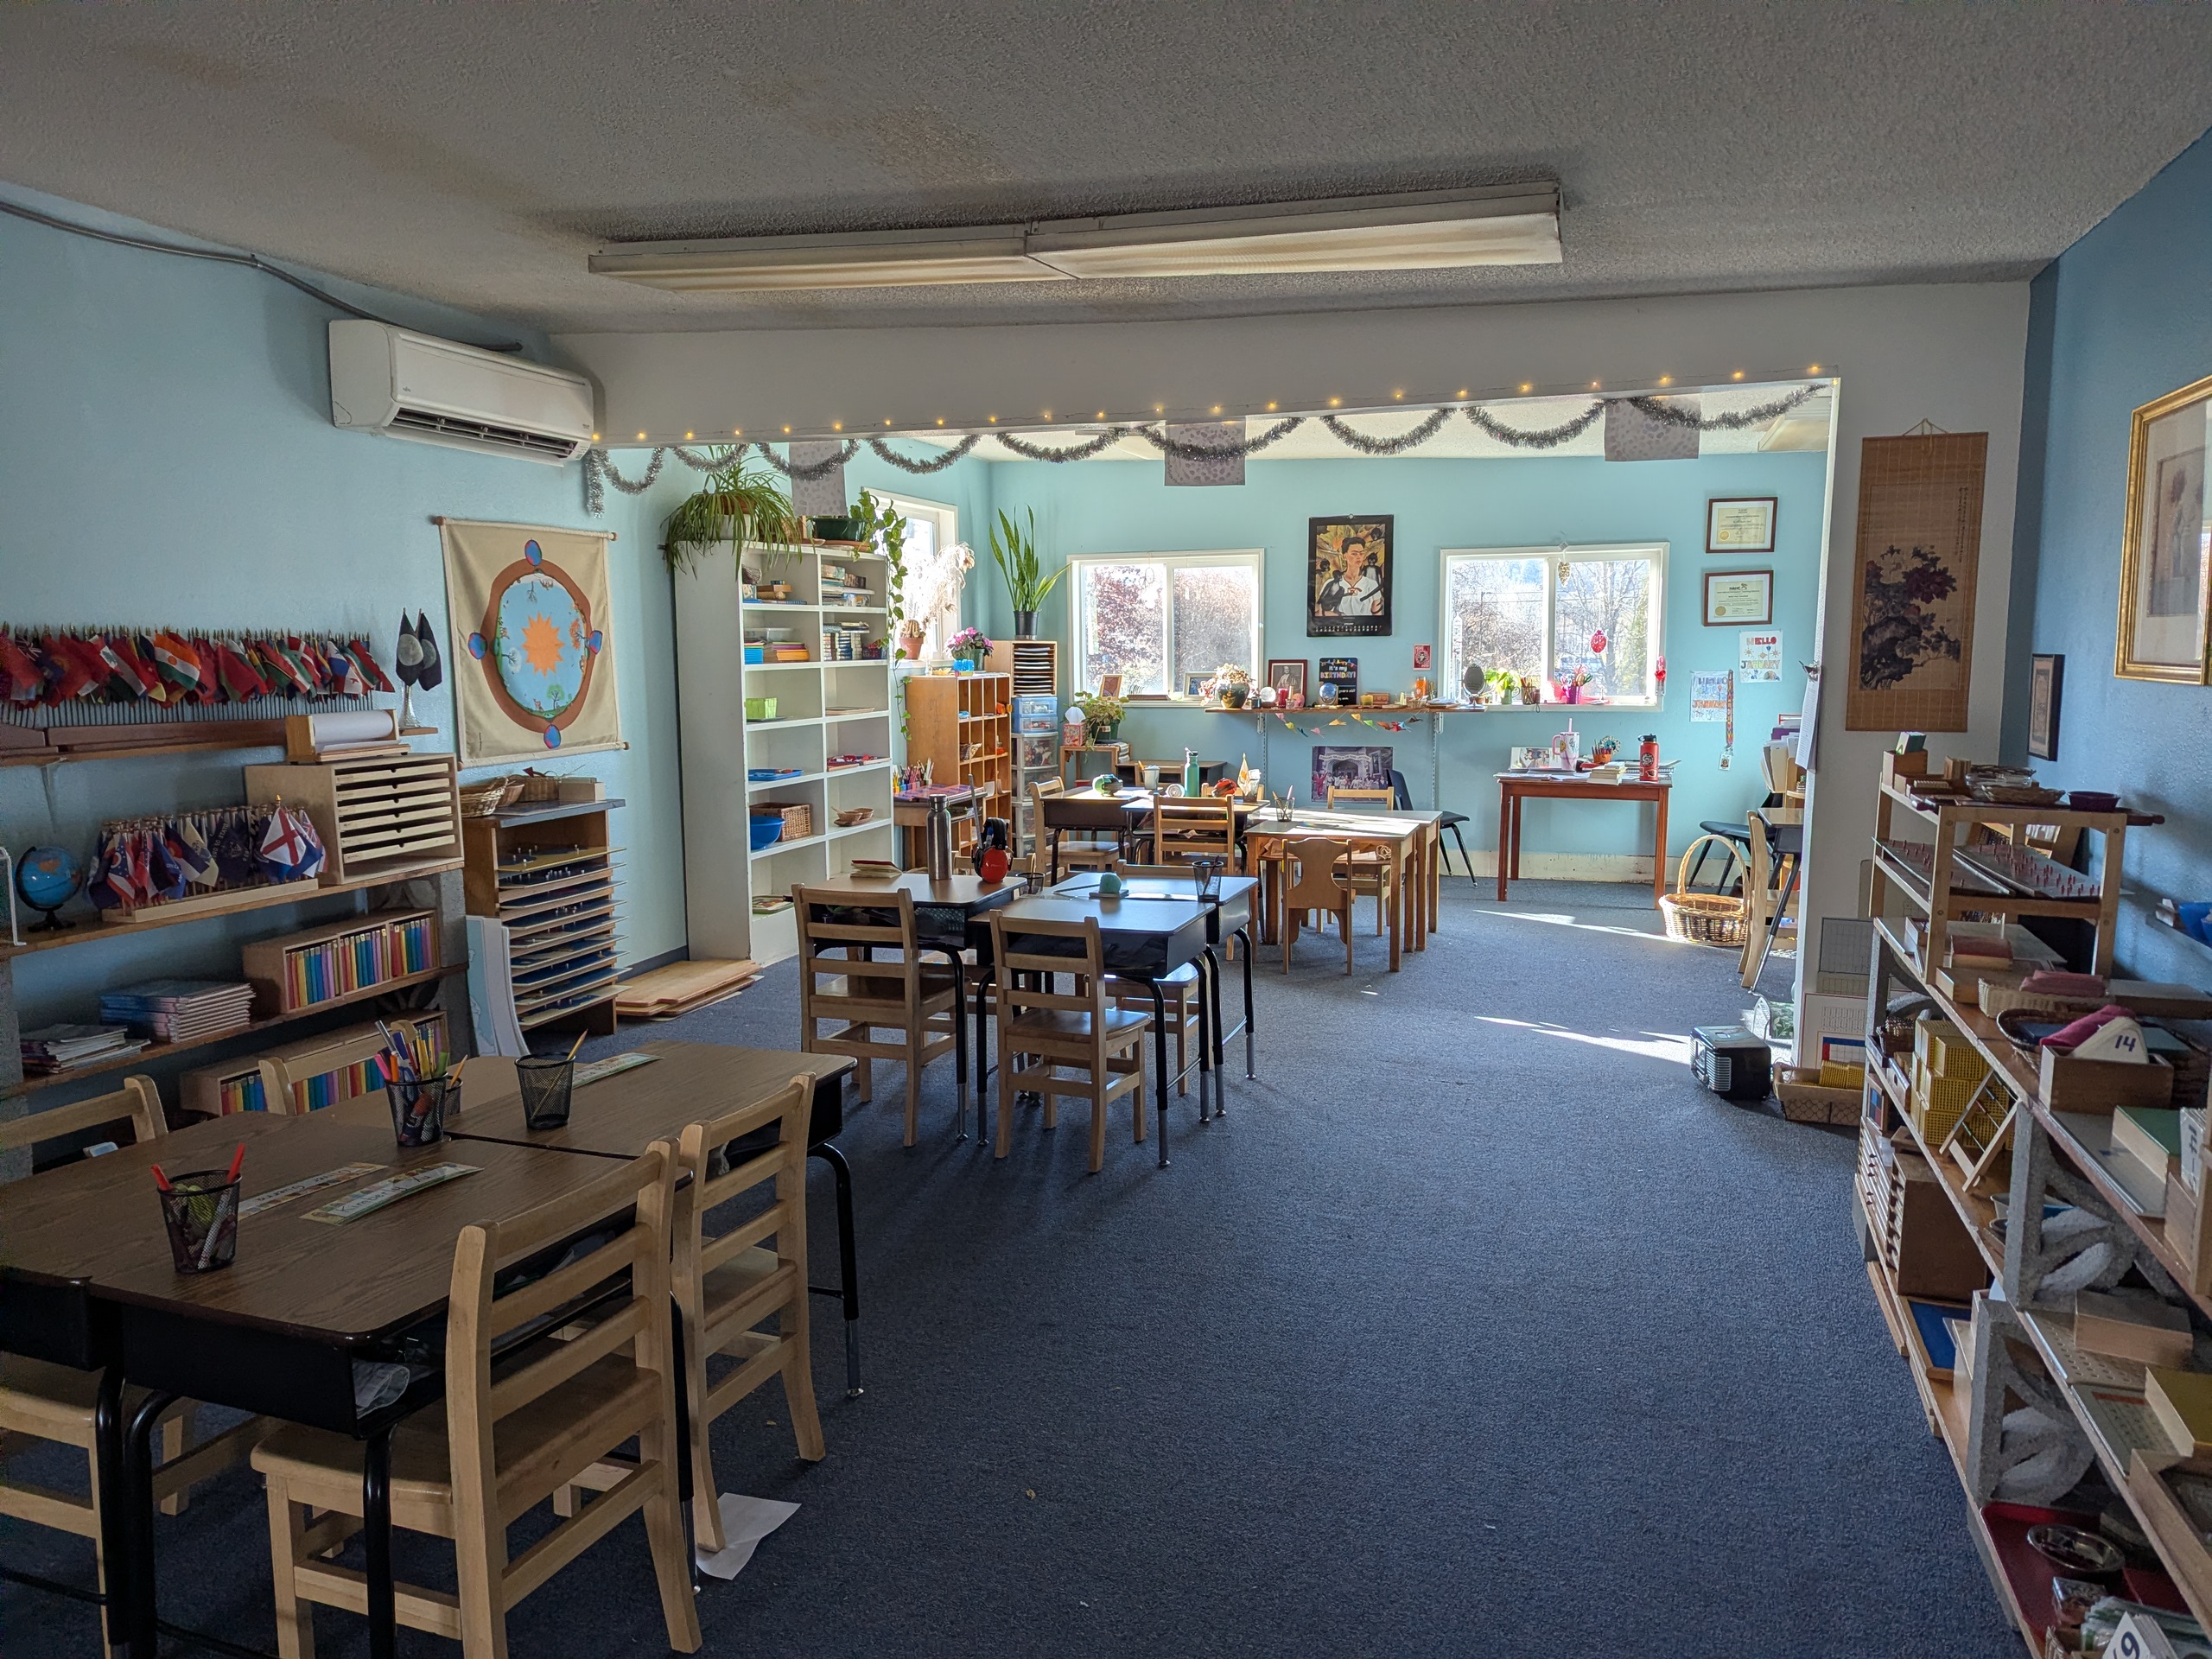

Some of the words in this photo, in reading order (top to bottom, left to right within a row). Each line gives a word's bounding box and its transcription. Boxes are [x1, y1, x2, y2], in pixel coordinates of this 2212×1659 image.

[1746, 636, 1777, 645] HELLO
[1740, 659, 1781, 670] JANUARY
[1698, 677, 1728, 685] HELLO
[2114, 1034, 2137, 1052] 14
